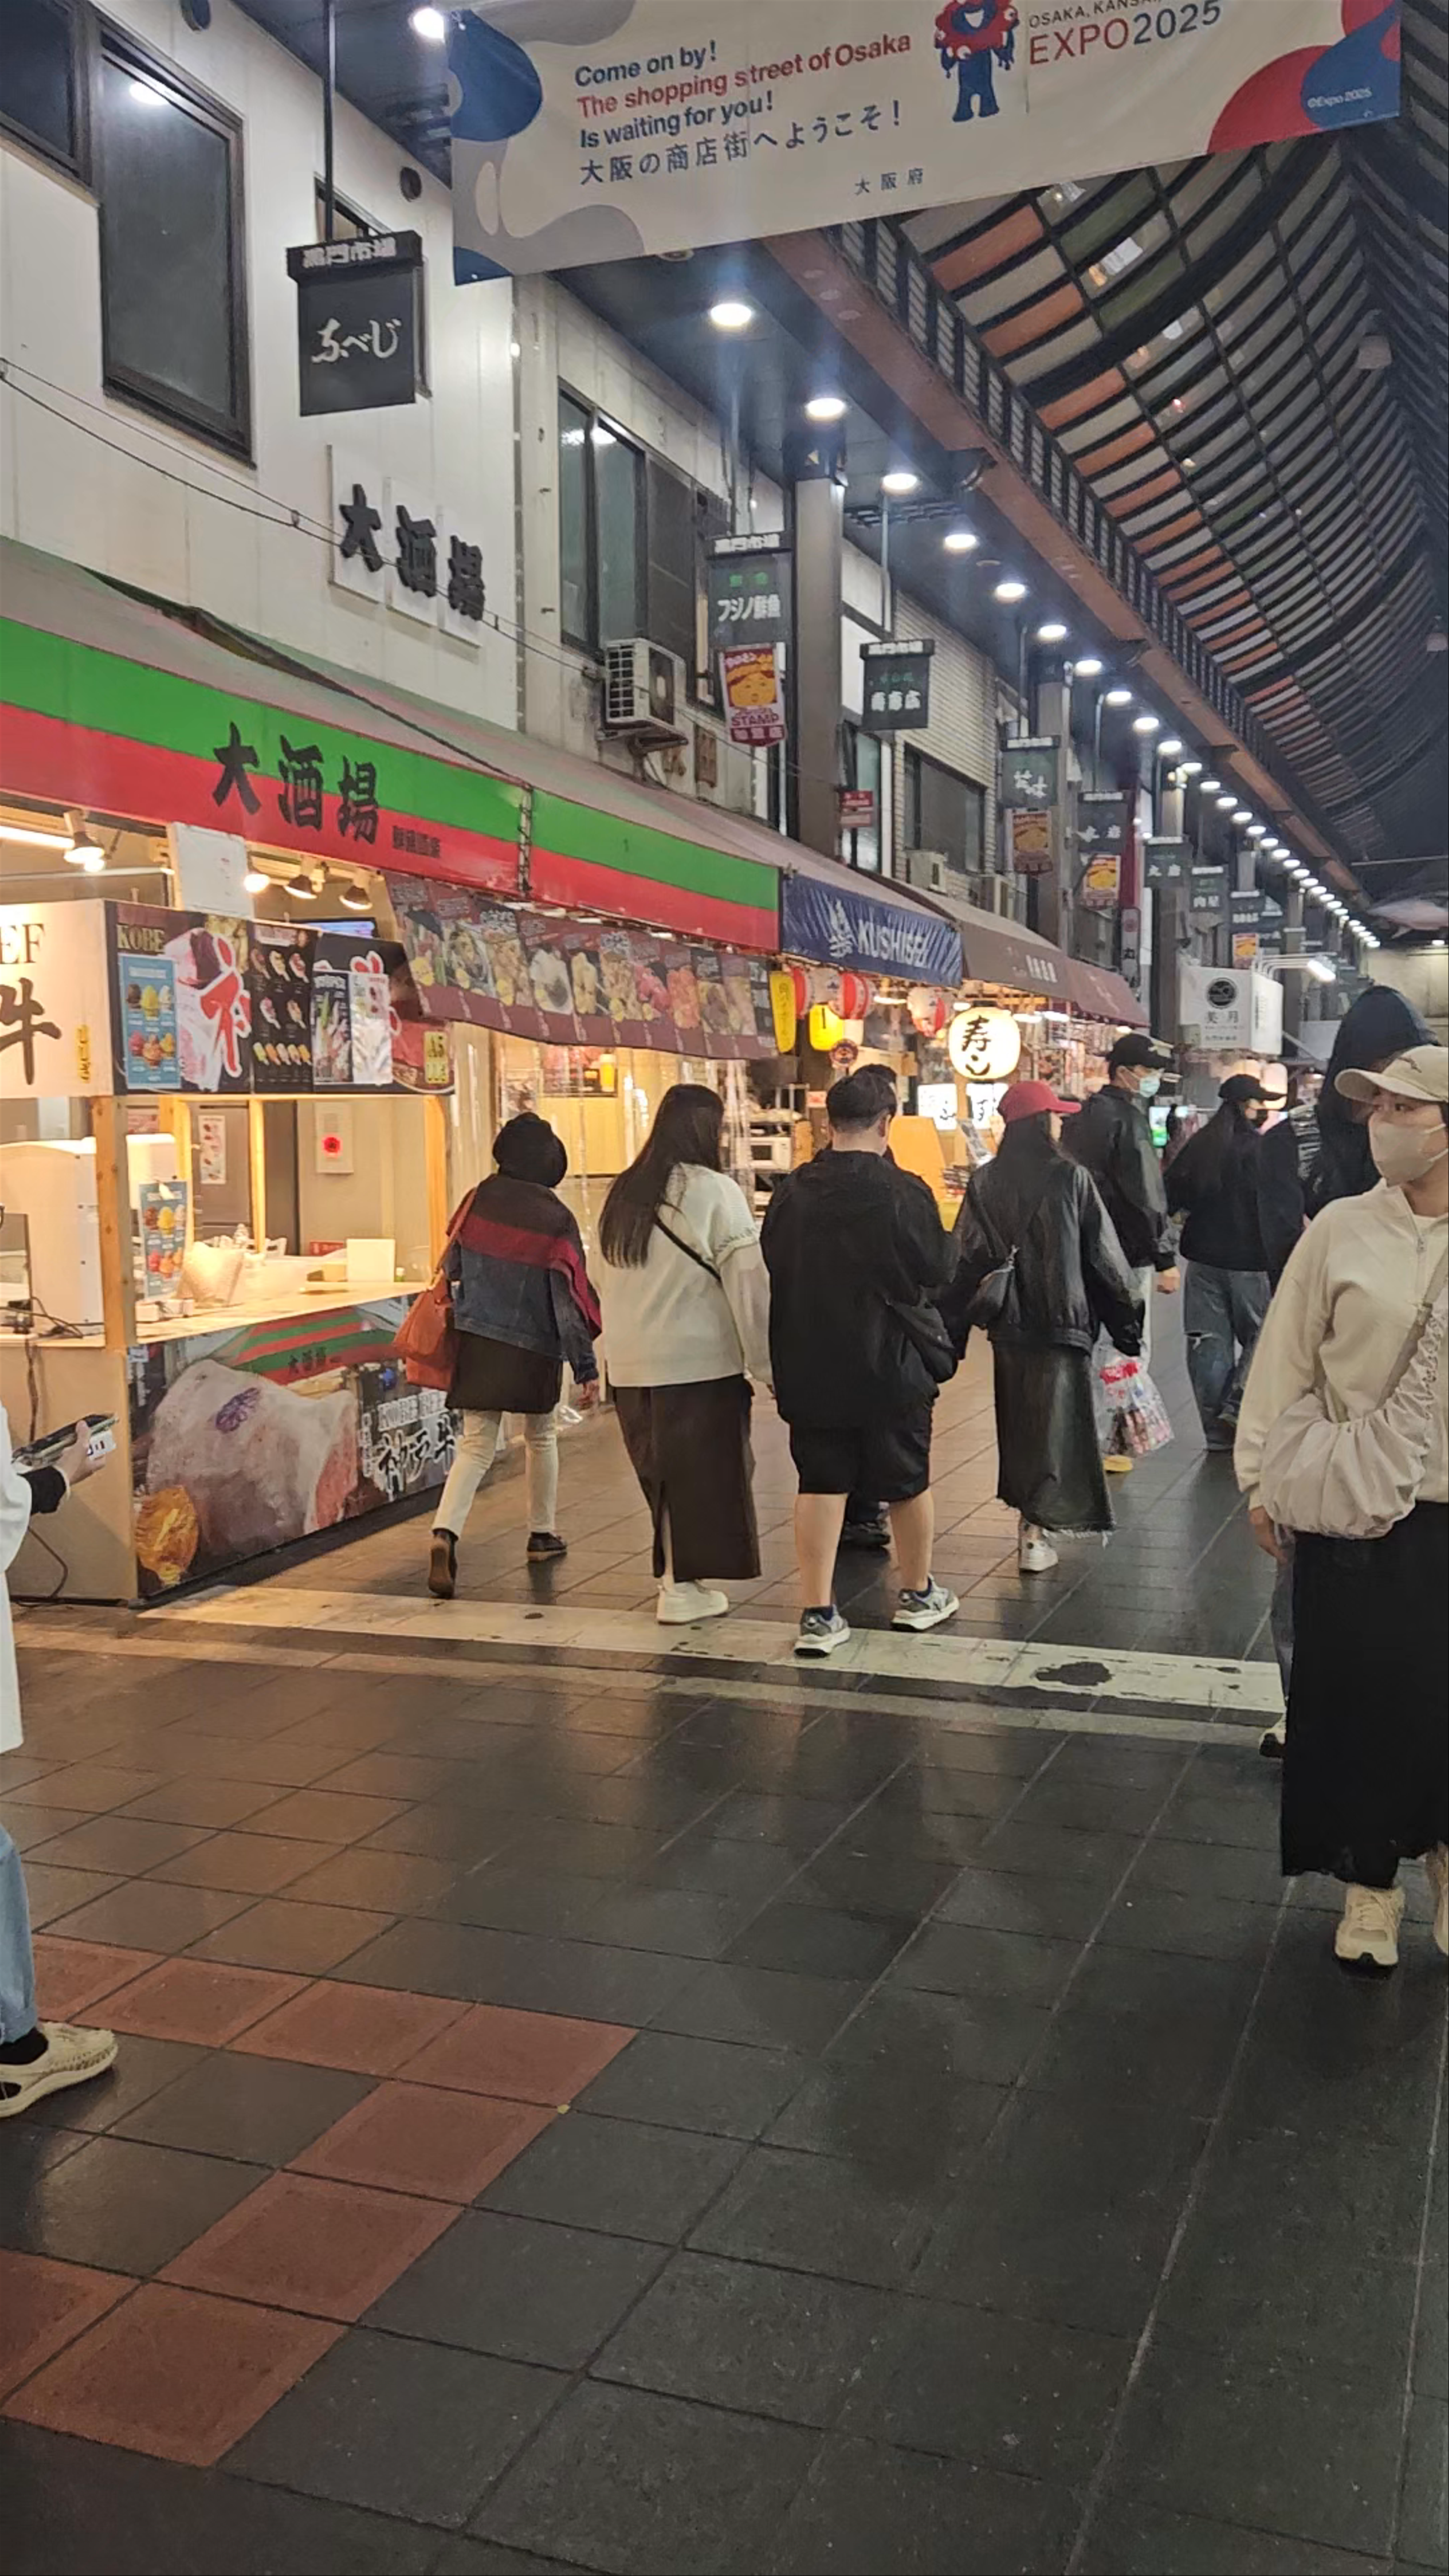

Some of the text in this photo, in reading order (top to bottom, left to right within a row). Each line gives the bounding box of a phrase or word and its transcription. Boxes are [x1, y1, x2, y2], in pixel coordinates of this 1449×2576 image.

[1029, 6, 1090, 28] OSAKA,
[575, 39, 716, 87] Come on by!
[577, 34, 911, 118] The shopping street of Osaka
[580, 90, 772, 148] Is waiting for you!
[854, 167, 924, 195] 大阪府
[212, 721, 379, 845] 大酒場
[117, 925, 165, 953] KOBE
